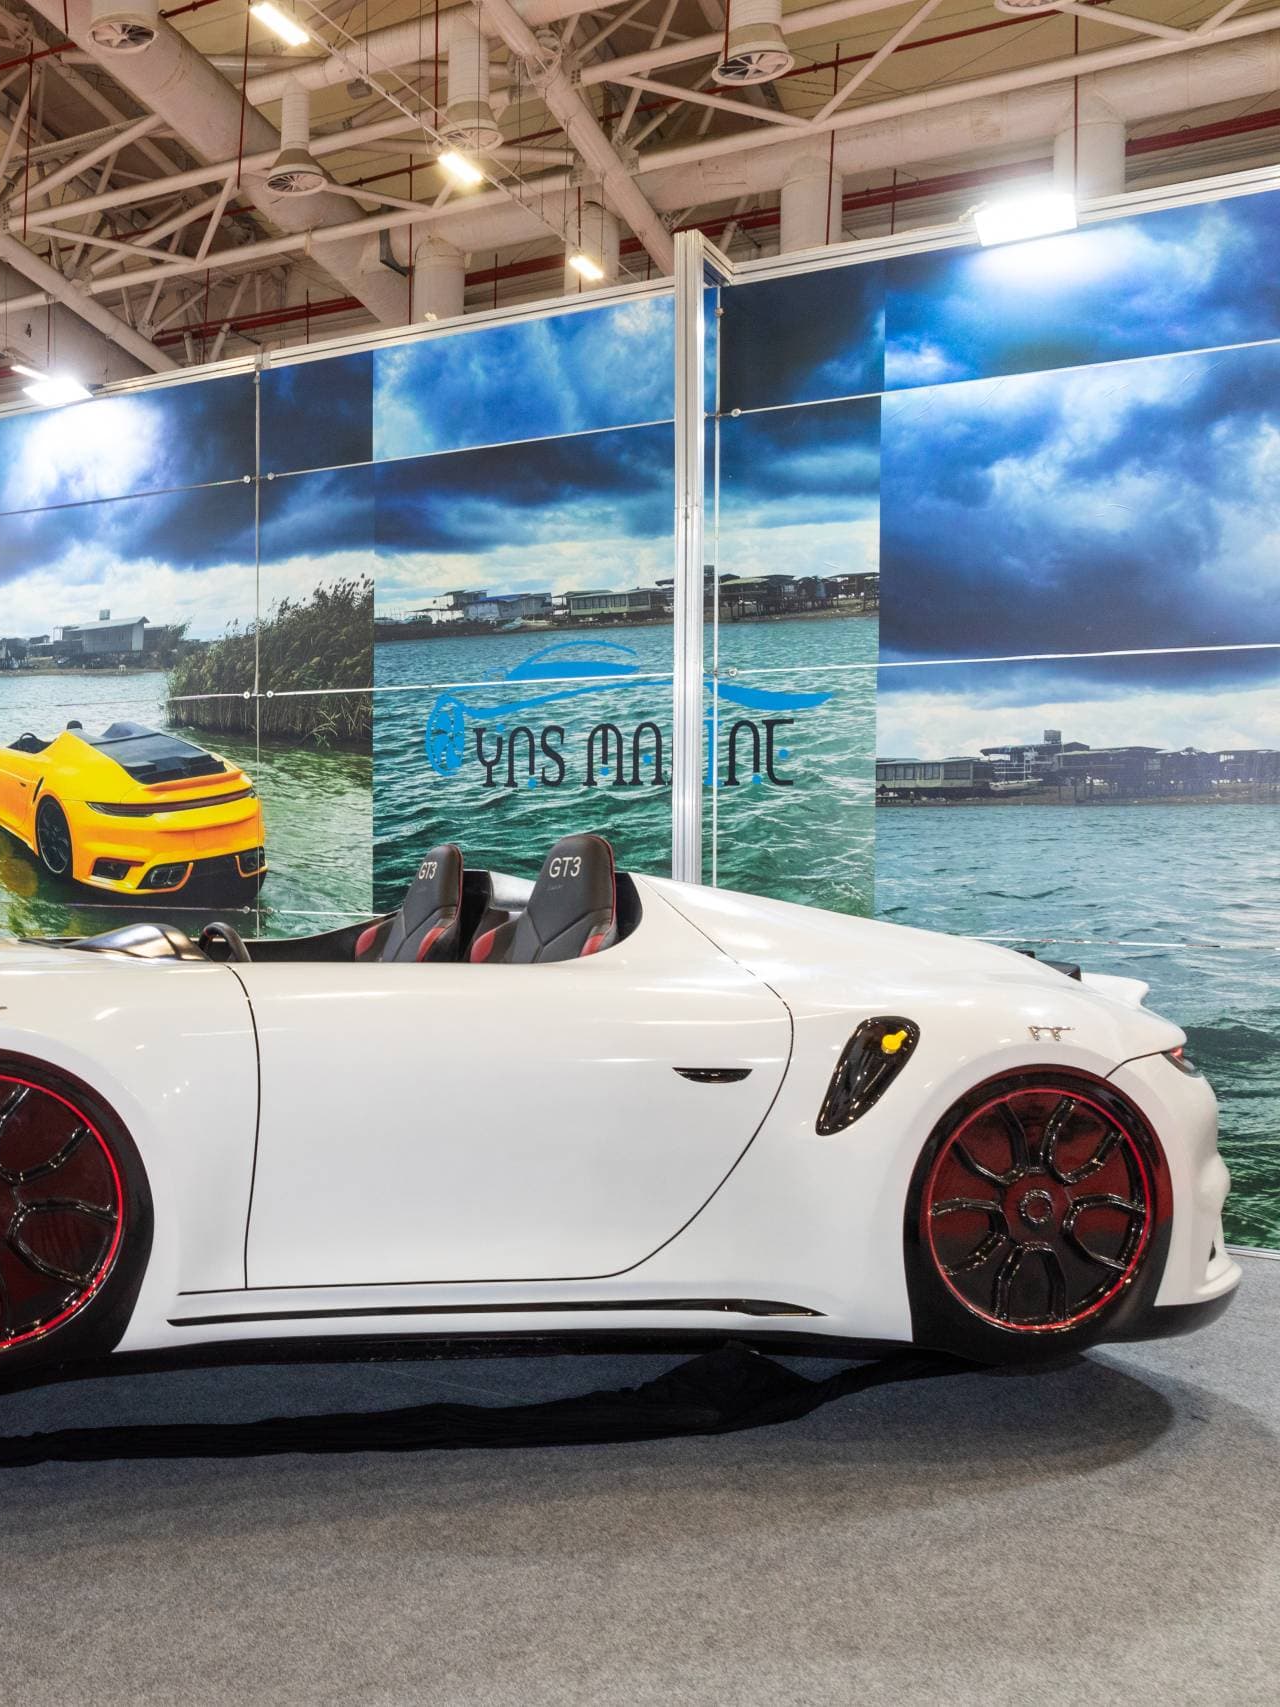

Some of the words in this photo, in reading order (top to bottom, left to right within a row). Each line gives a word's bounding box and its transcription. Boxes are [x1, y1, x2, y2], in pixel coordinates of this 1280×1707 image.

[473, 726, 565, 788] YNS
[583, 716, 794, 788] MAINE
[418, 862, 438, 880] GT3
[549, 856, 582, 879] GT3
